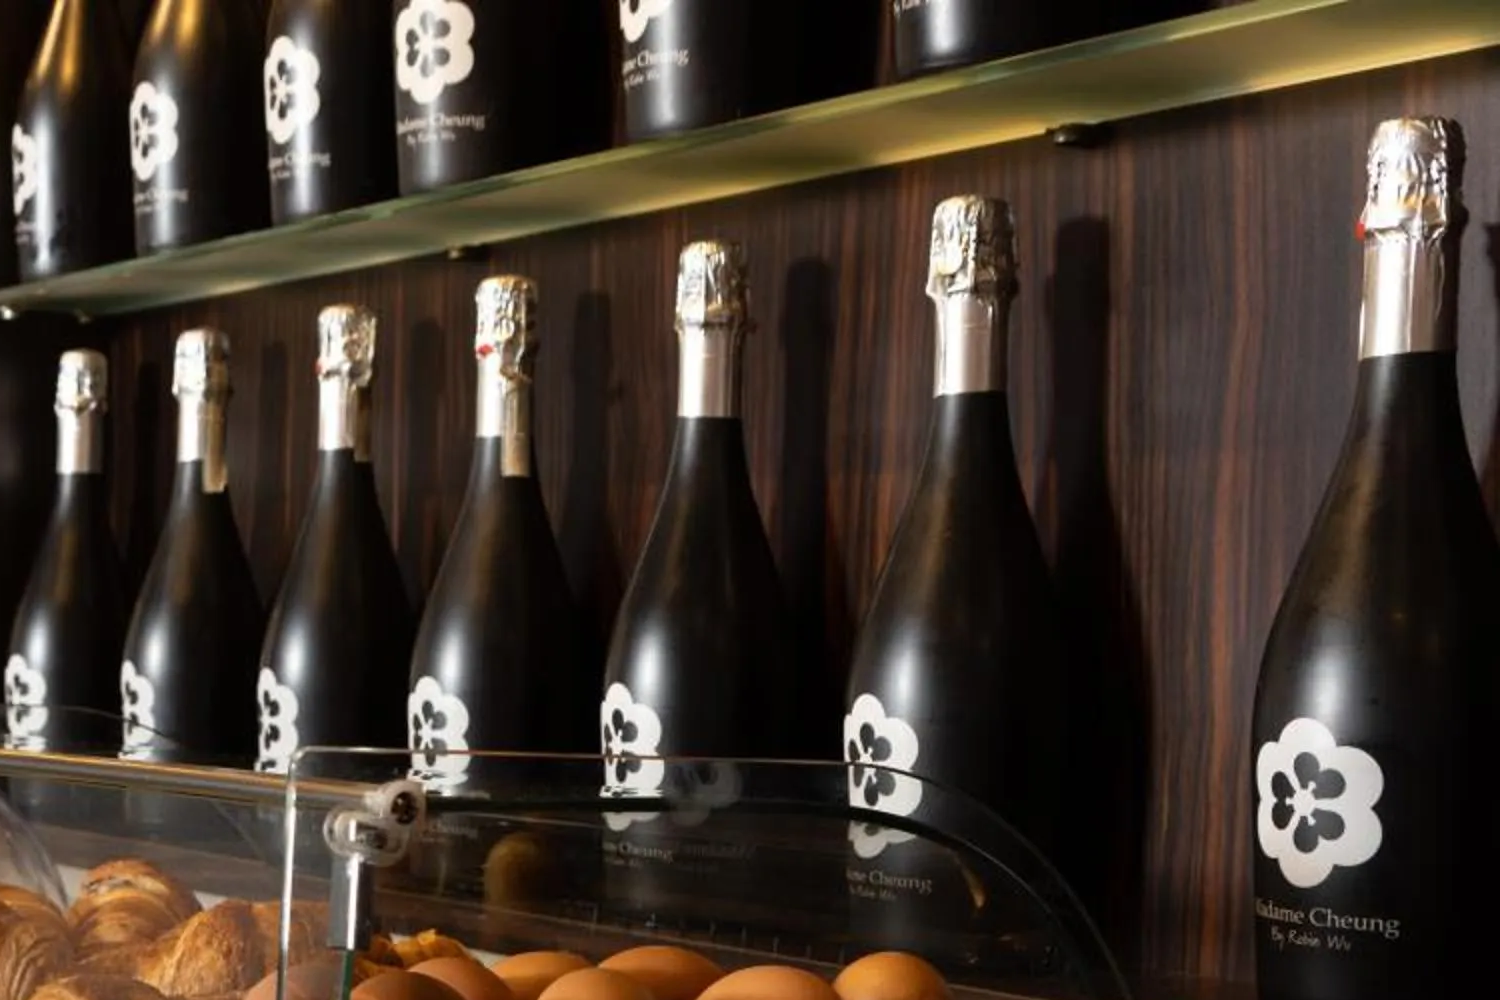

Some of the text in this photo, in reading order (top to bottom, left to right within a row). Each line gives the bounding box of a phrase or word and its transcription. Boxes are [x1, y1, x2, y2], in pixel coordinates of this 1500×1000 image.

[1255, 898, 1402, 941] adame Cheung
[1271, 926, 1286, 953] By
